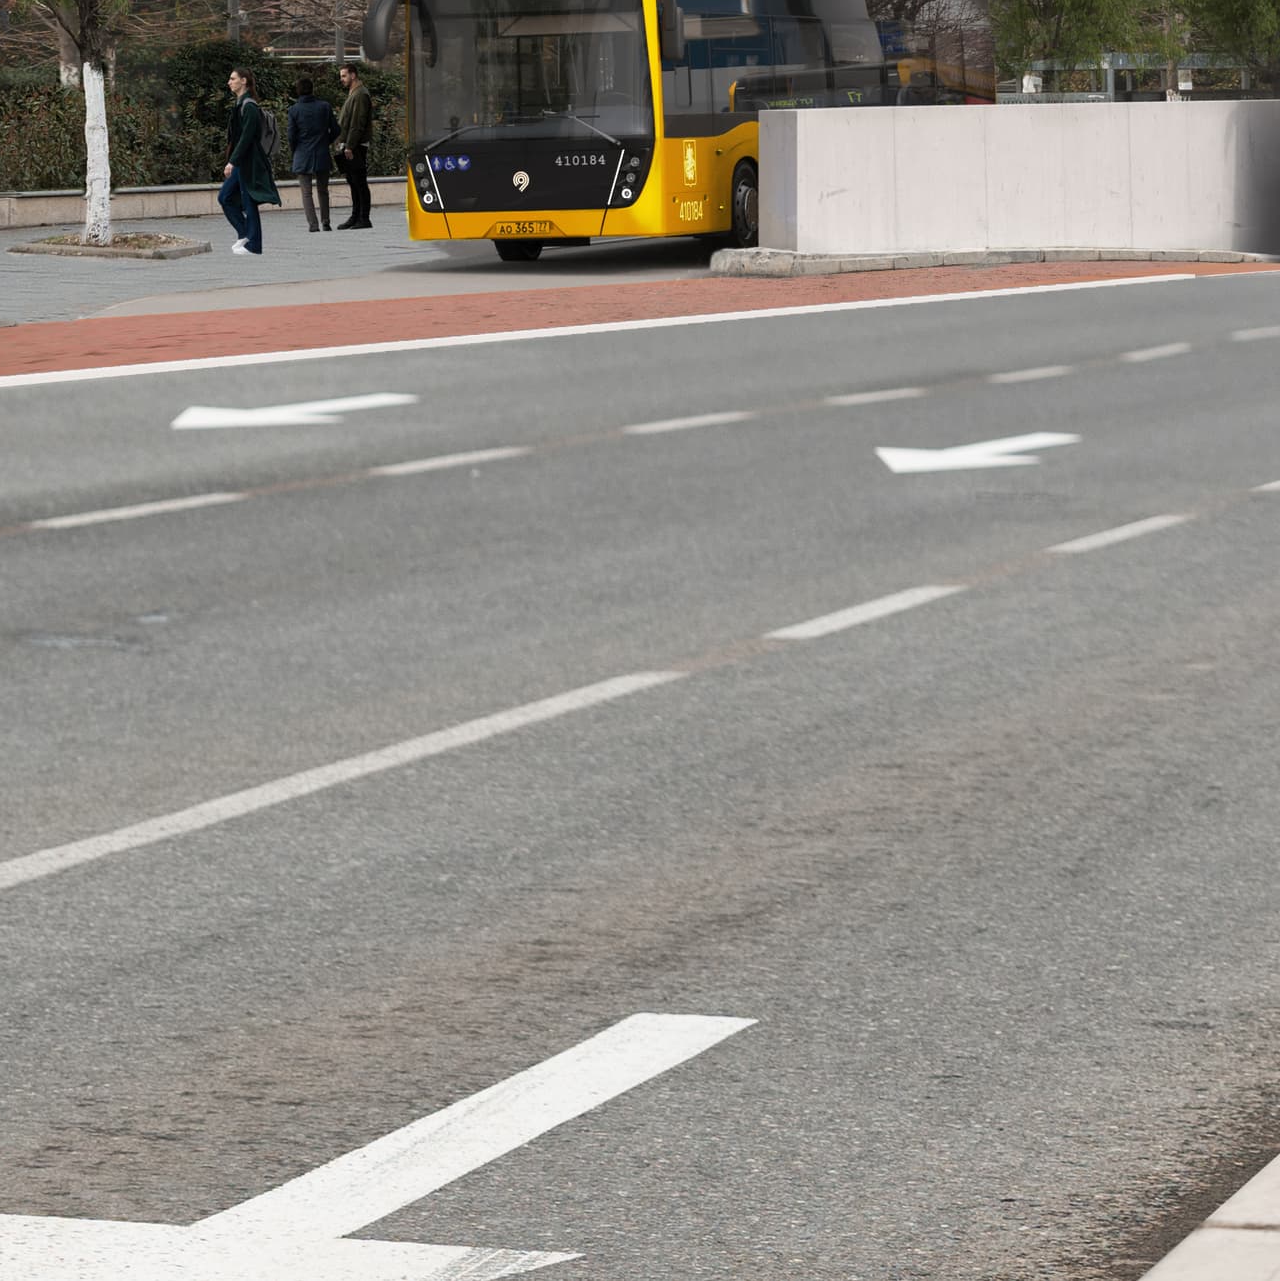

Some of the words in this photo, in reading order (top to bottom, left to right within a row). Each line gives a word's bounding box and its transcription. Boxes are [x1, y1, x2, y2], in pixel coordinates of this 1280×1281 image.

[554, 154, 606, 166] 410184
[679, 200, 703, 221] 410184
[515, 222, 535, 233] 365
